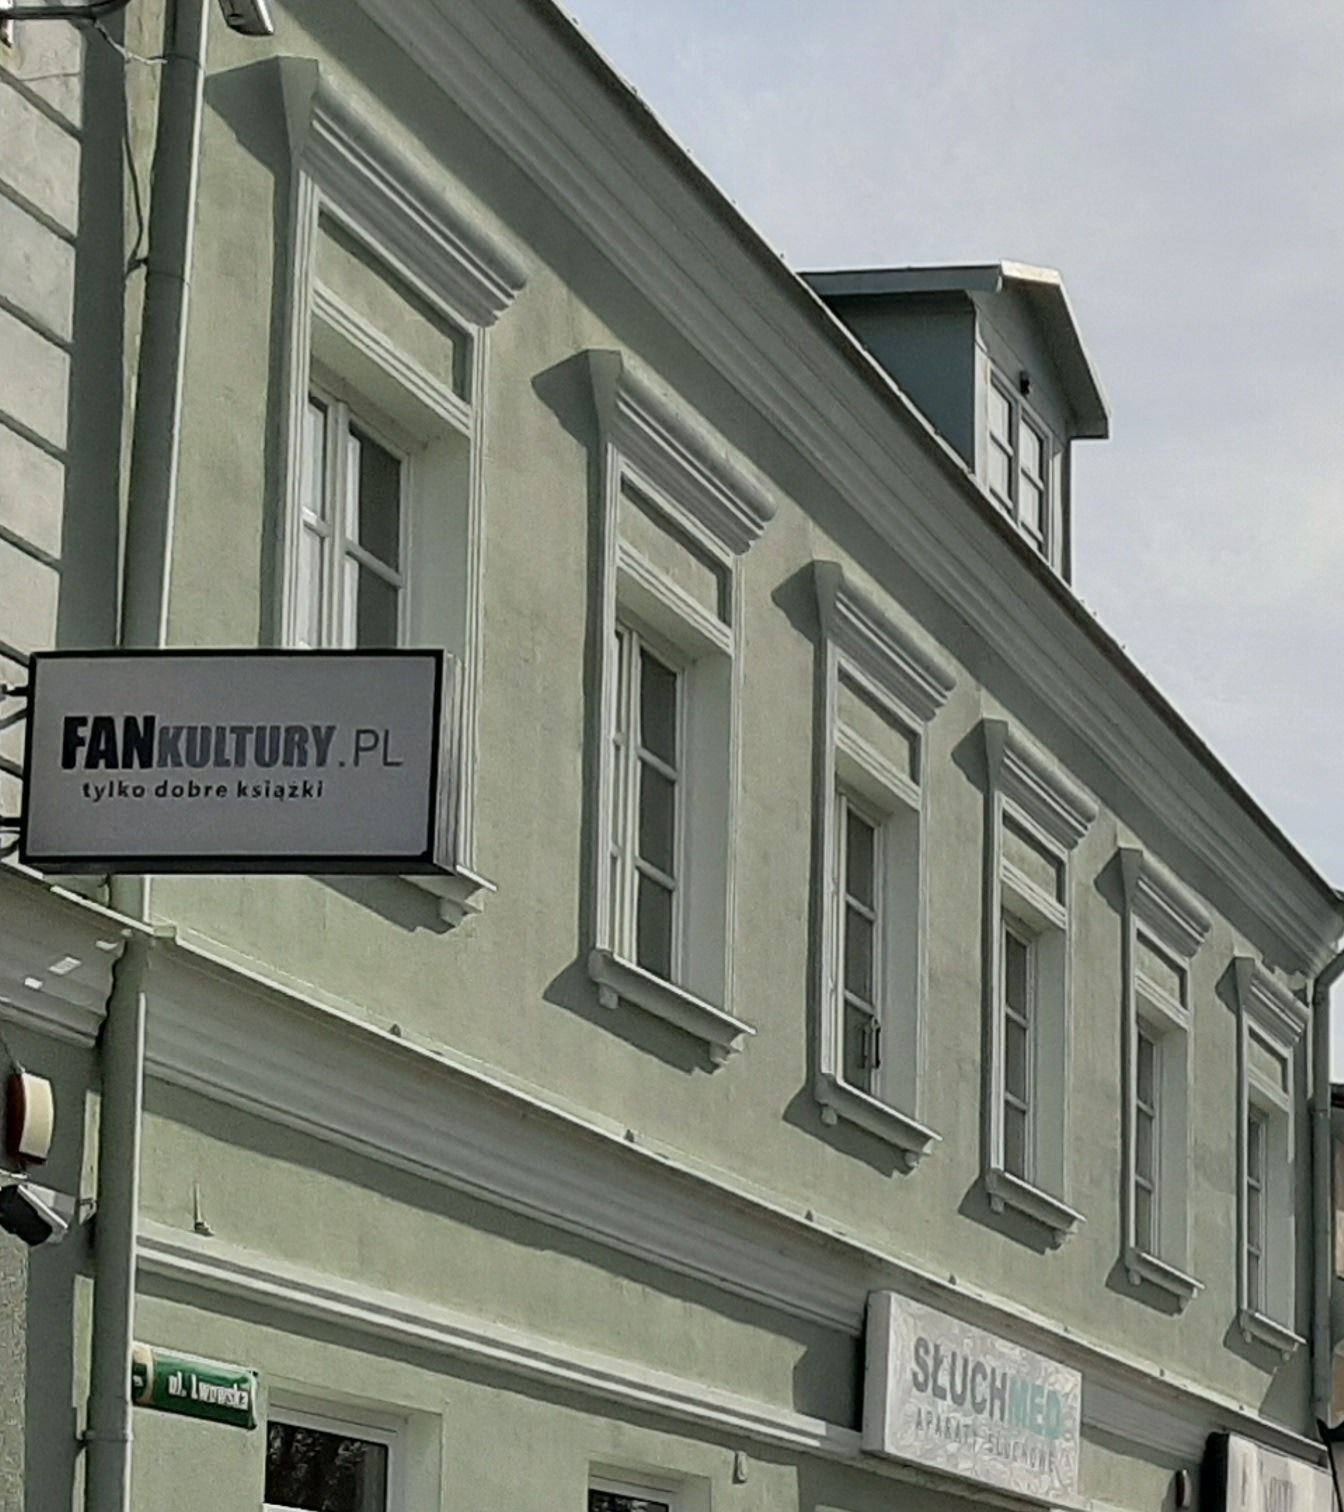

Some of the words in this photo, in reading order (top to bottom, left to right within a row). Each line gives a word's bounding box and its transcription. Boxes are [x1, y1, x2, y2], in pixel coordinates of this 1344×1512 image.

[61, 715, 404, 770] FANKULTURY.PL
[82, 780, 146, 803] tylko
[154, 779, 228, 799] dobre
[236, 779, 324, 803] książki
[167, 1370, 188, 1398] ul.
[191, 1372, 249, 1411] Lwowska
[911, 1336, 1063, 1440] SŁUCHMED
